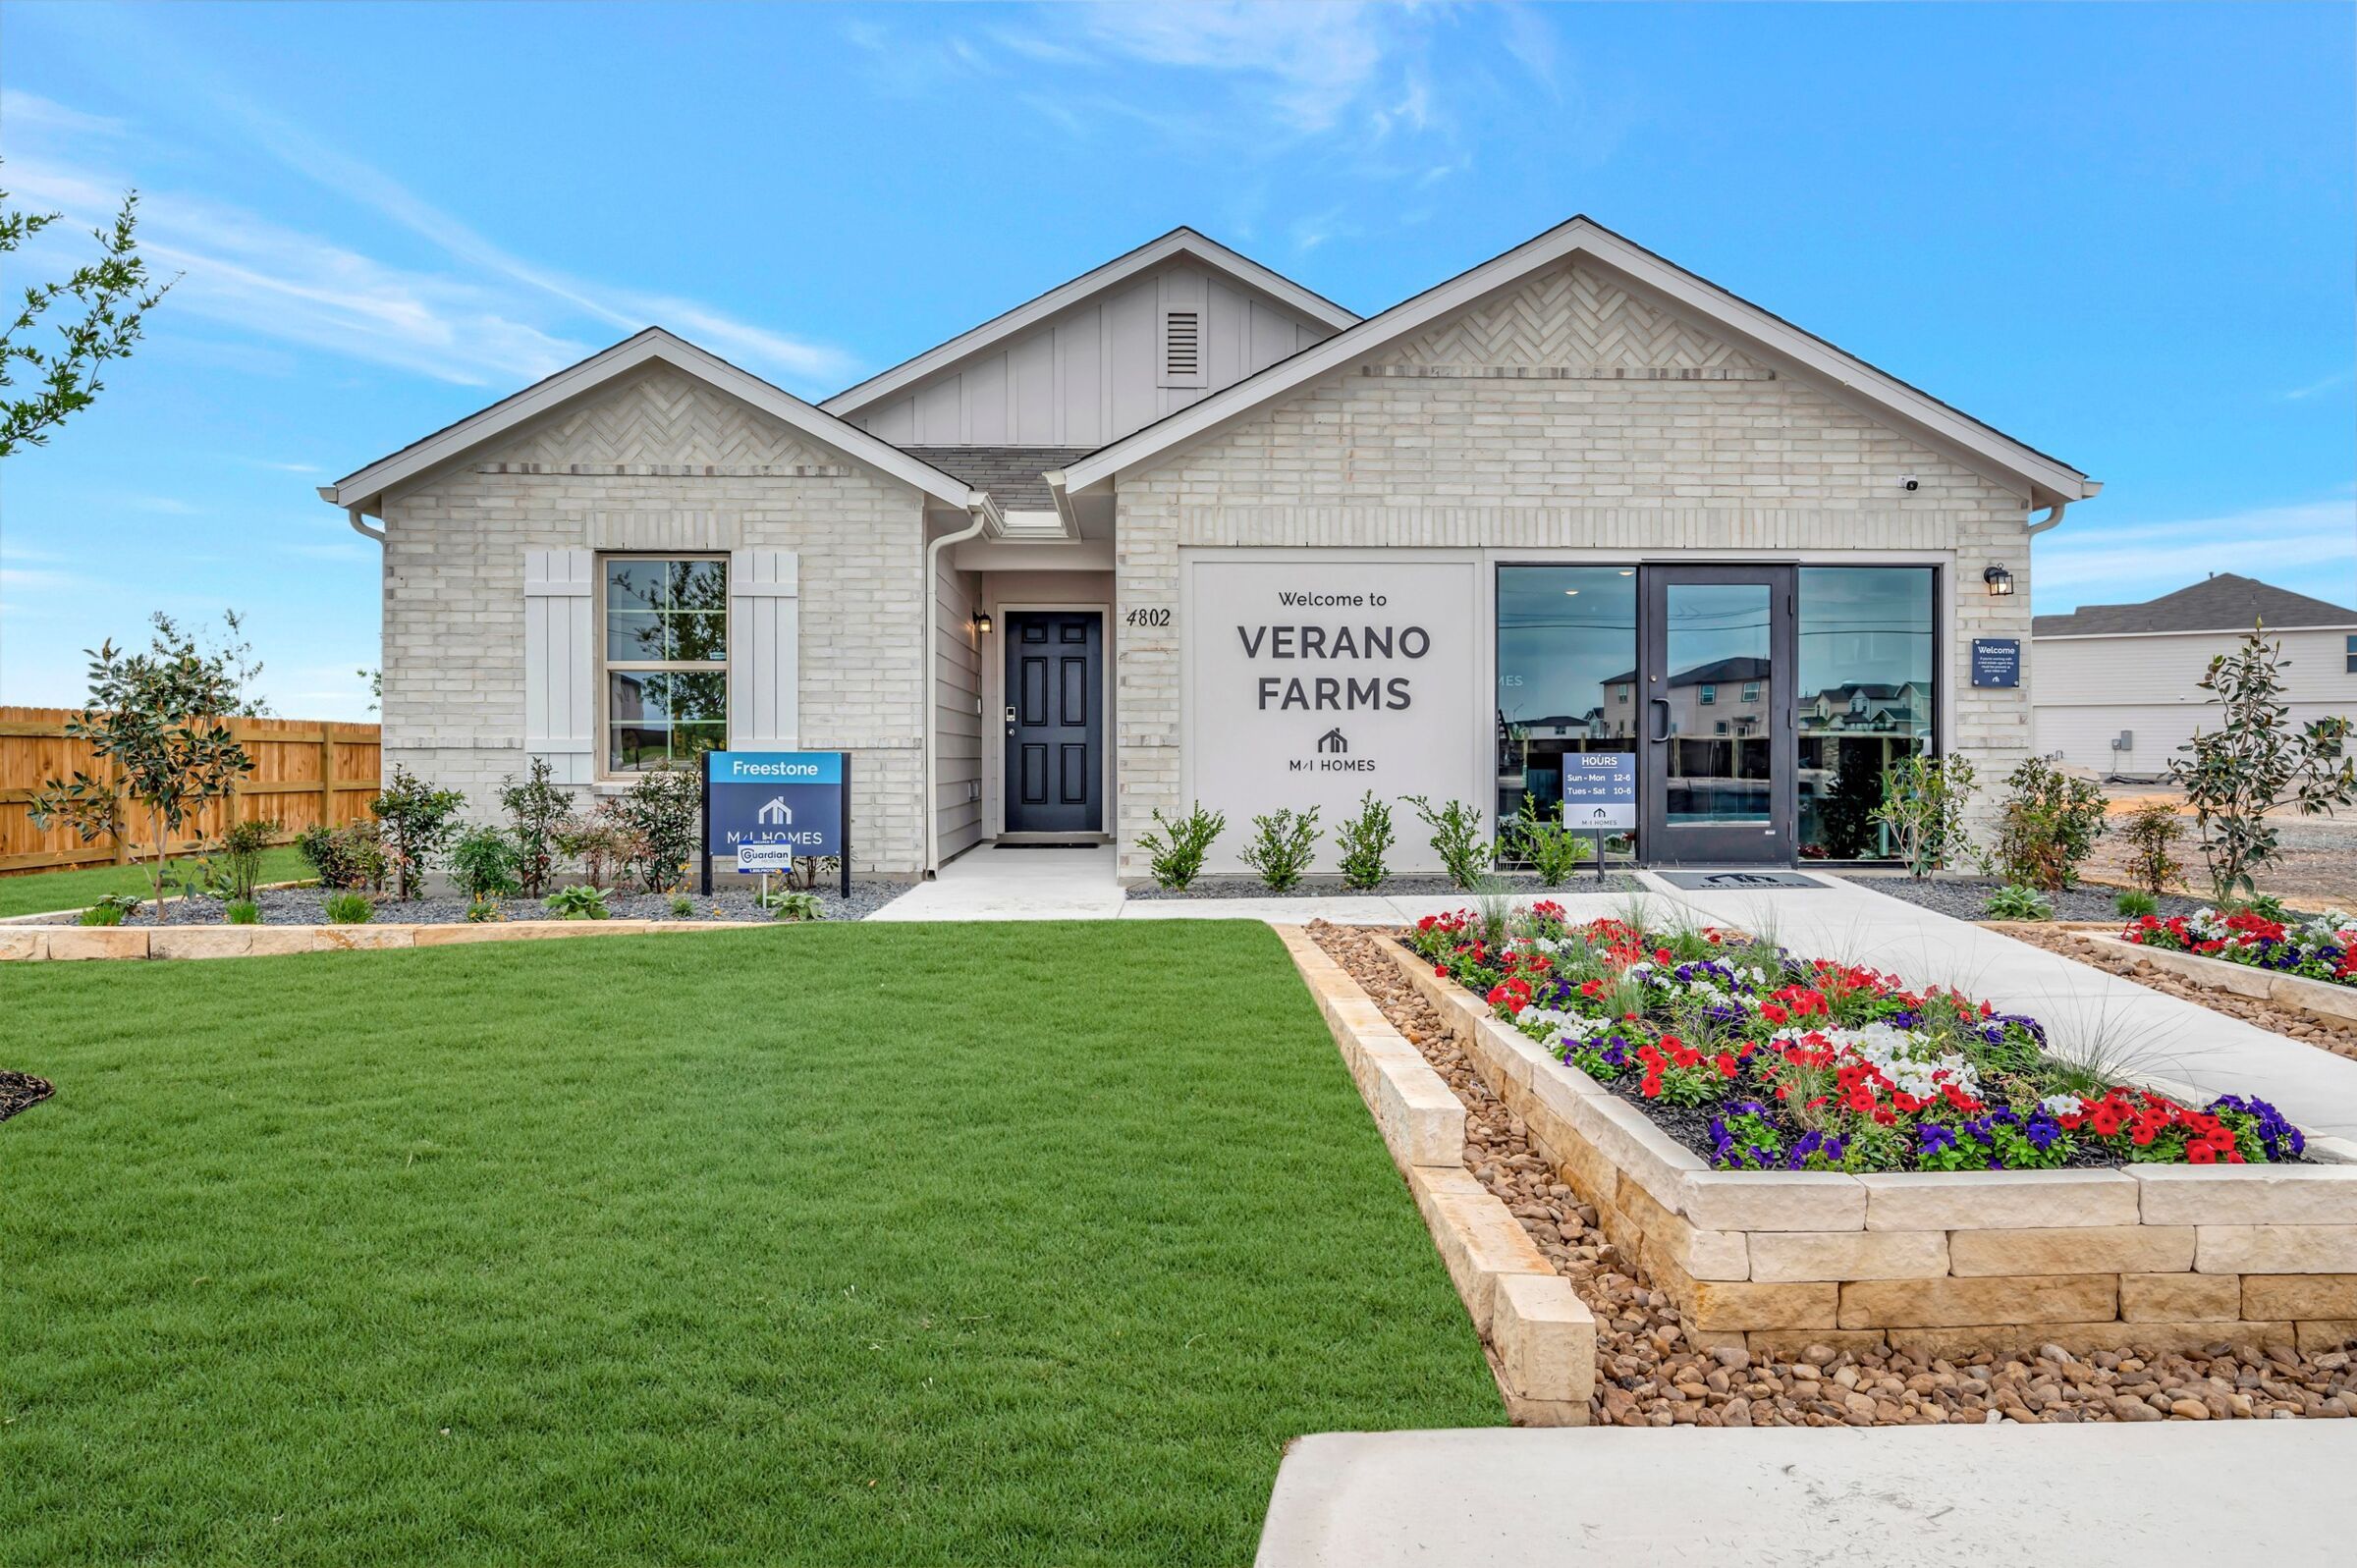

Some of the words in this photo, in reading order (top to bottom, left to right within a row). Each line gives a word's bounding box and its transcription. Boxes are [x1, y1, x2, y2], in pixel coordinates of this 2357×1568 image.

[1279, 592, 1363, 606] Welcome
[1370, 592, 1387, 606] to
[1126, 608, 1171, 626] 4802
[1236, 625, 1431, 659] VERANO
[1978, 645, 2015, 654] Welcome
[1258, 677, 1411, 710] FARMS
[1289, 760, 1313, 772] M/I
[1321, 760, 1375, 772] HOMES
[1581, 756, 1617, 766] HOURS
[733, 761, 818, 776] Freestone
[762, 832, 823, 844] HOMES
[743, 850, 789, 859] Guardian
